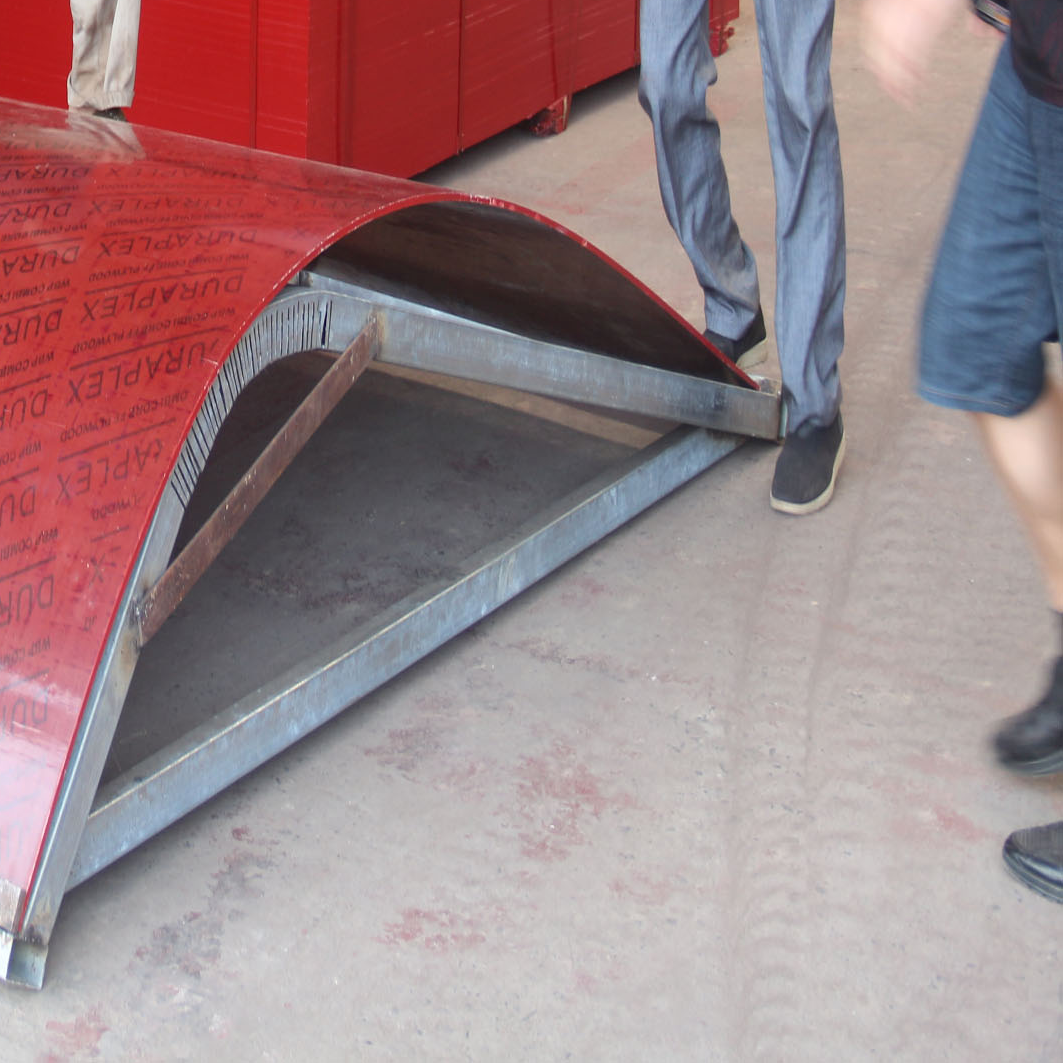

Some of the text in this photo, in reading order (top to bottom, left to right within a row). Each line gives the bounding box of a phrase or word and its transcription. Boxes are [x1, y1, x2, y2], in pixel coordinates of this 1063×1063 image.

[98, 230, 255, 257] DURAPLEX
[82, 278, 242, 322] DURAPLEX
[55, 438, 159, 503] APLEX
